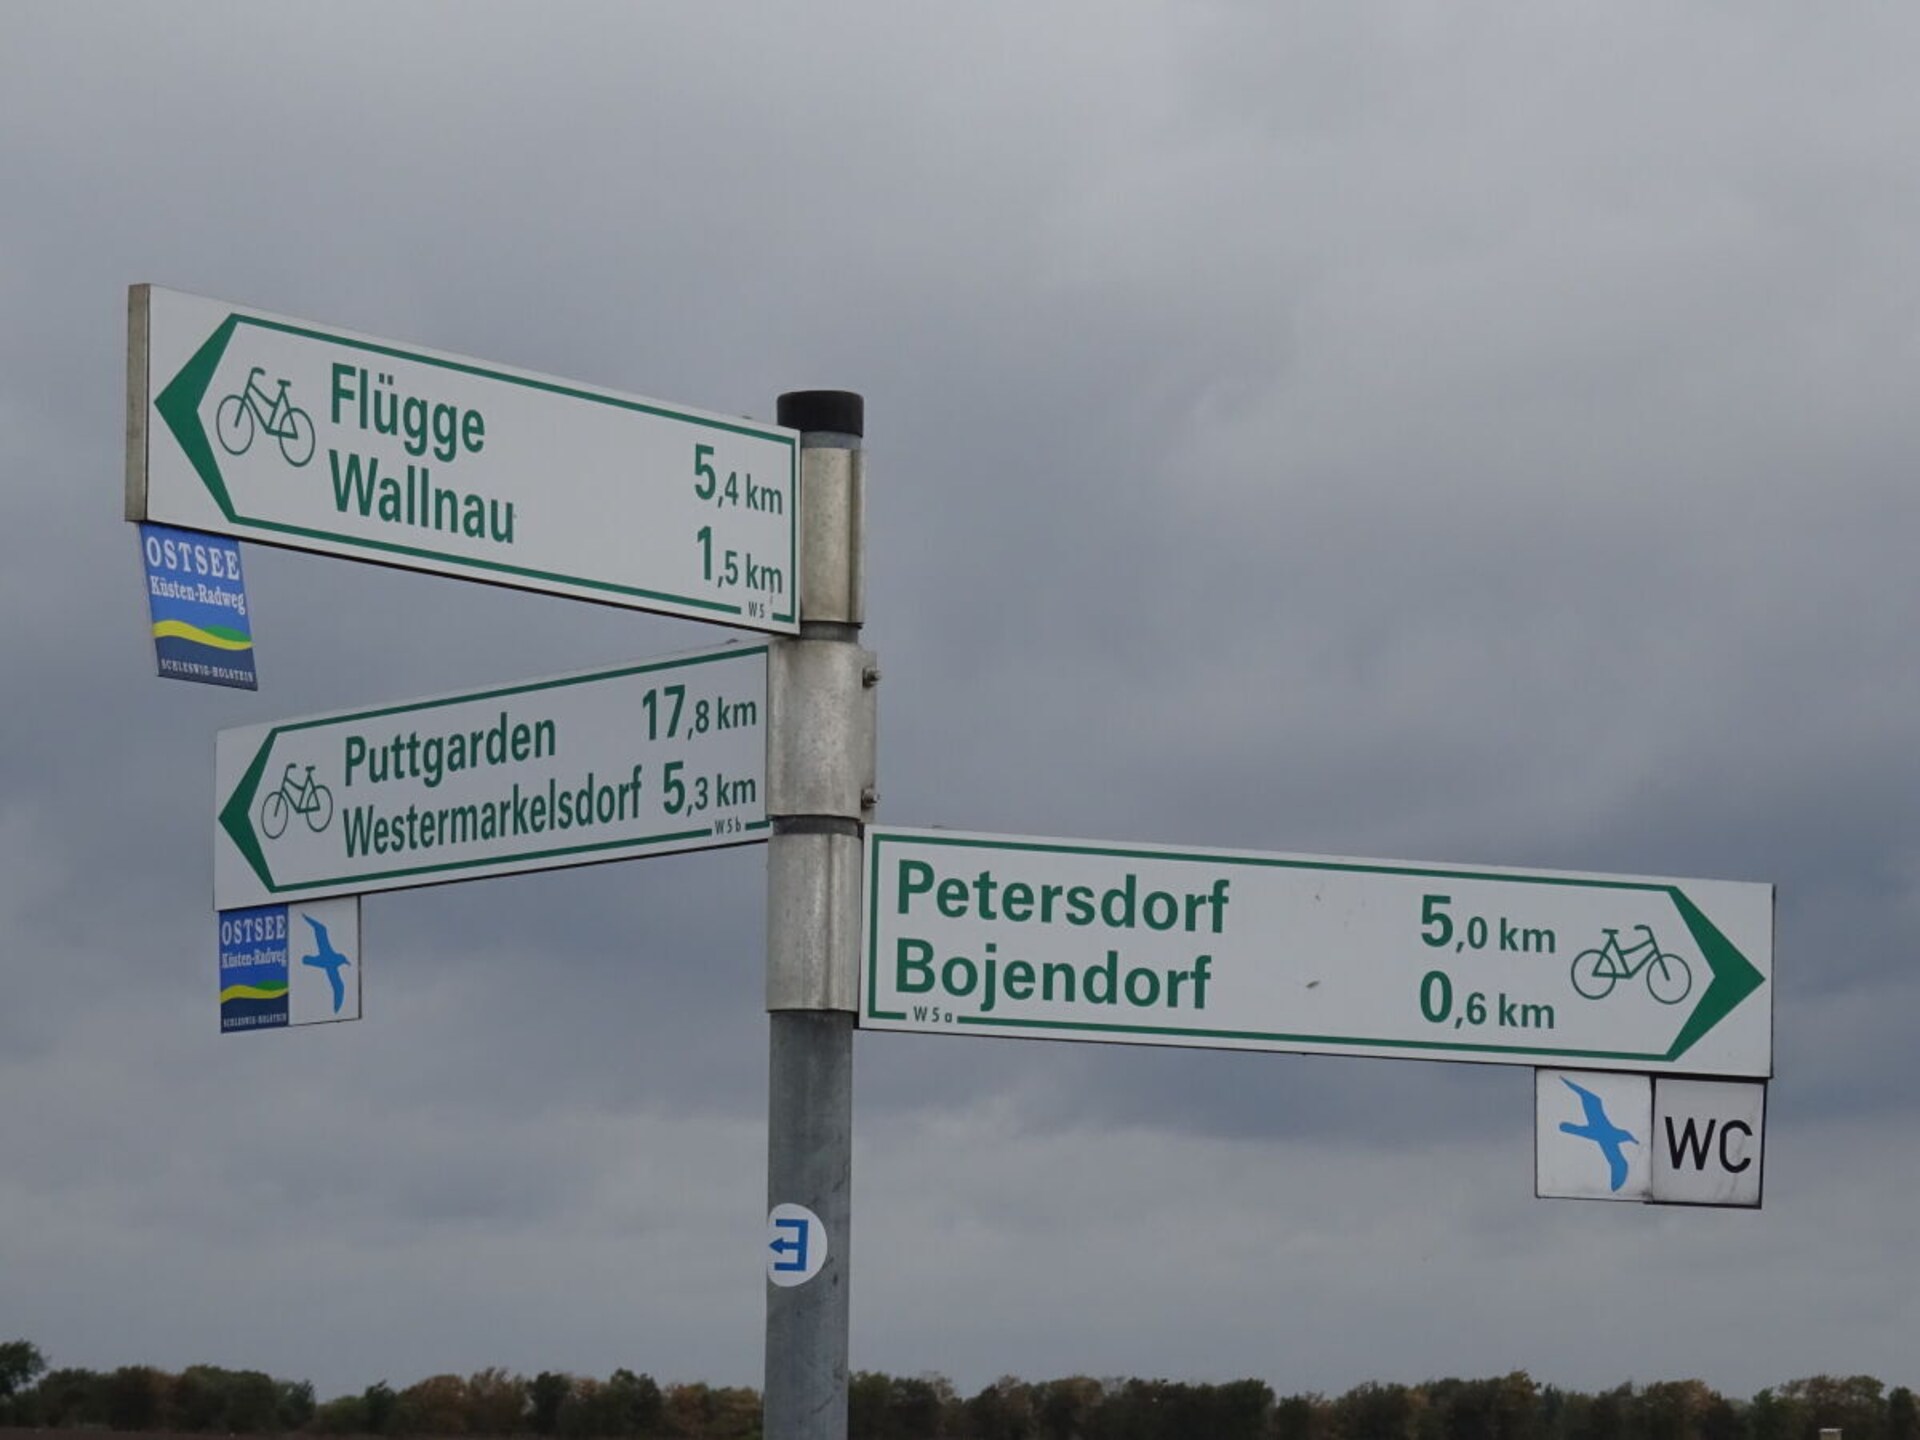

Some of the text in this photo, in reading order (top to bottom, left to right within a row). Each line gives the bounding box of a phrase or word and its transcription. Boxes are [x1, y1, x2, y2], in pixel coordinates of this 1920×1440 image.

[331, 362, 783, 516] Flügge 5,4 km
[146, 537, 240, 580] OSTSEE
[329, 449, 783, 594] Wallnau 1,5 km
[150, 575, 245, 615] Küsten-Radweg
[344, 685, 757, 787] Puttgarden 17,8 km
[343, 760, 757, 858] Westermarkelsdorf 5,3 km
[221, 914, 287, 946] OSTSEE
[897, 859, 1556, 953] Petersdorf 5,0 km
[896, 937, 1555, 1029] Bojendorf 0,6 km
[1665, 1116, 1753, 1173] WC
